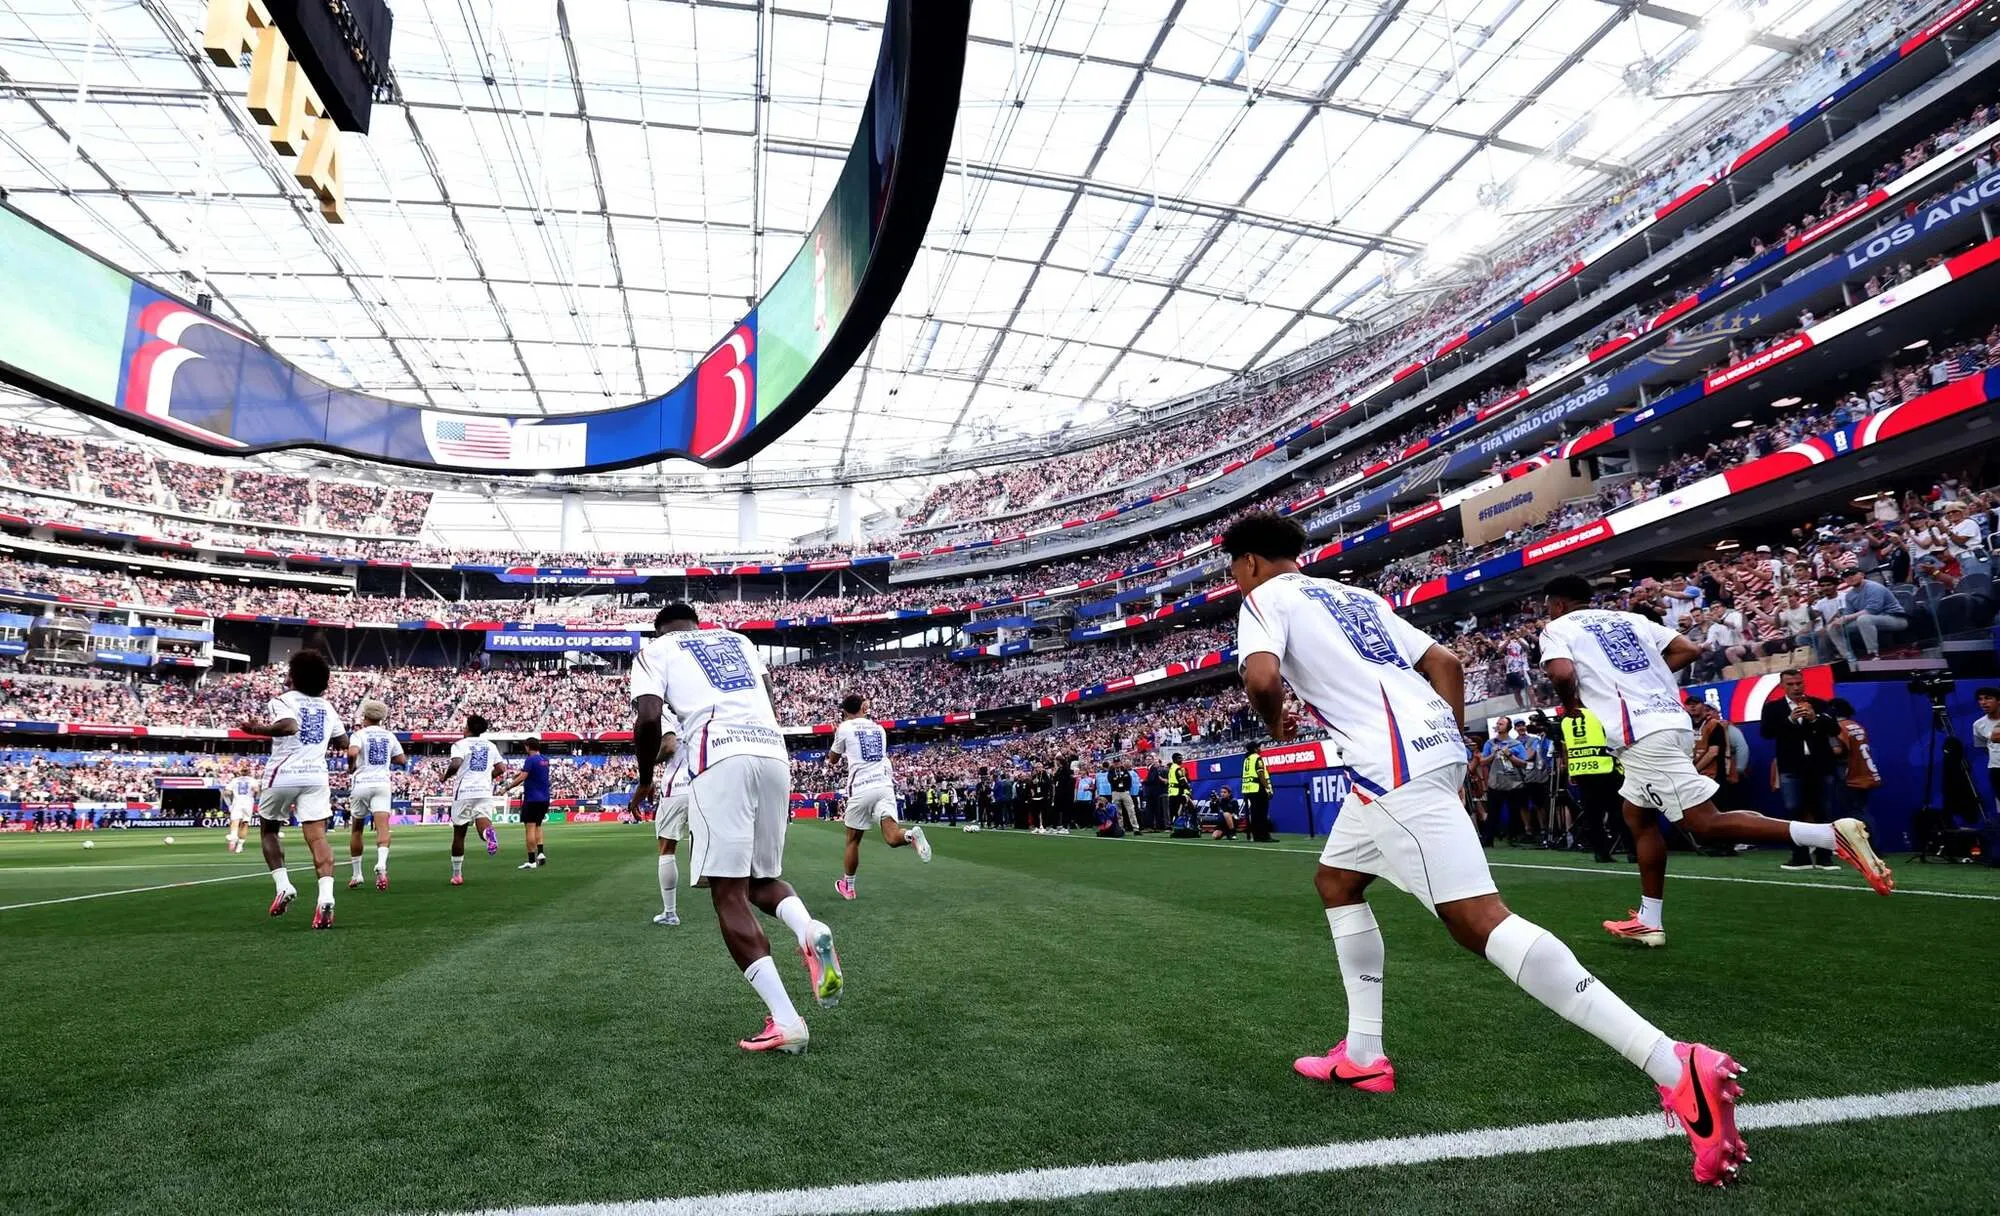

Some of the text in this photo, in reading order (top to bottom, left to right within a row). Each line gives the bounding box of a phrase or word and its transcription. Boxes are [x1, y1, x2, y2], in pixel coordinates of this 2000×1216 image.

[203, 0, 345, 224] FIFA
[1847, 223, 1915, 270] LOS
[1480, 437, 1503, 454] FIFA
[1502, 417, 1541, 443] WORLD
[1541, 404, 1565, 424] CUP
[1566, 383, 1609, 413] 2026
[1478, 491, 1534, 521] #FIFAWorldCup
[1309, 501, 1361, 531] ANGELES
[533, 576, 557, 584] LOS
[493, 635, 632, 646] FIFA WORLD CUP 2026
[711, 734, 742, 749] Men's
[727, 728, 757, 737] United
[1411, 730, 1449, 752] Men's
[1295, 750, 1316, 763] 2026
[1568, 747, 1600, 758] ECURITY
[1569, 761, 1599, 772] 07958
[1312, 774, 1347, 803] FIFA
